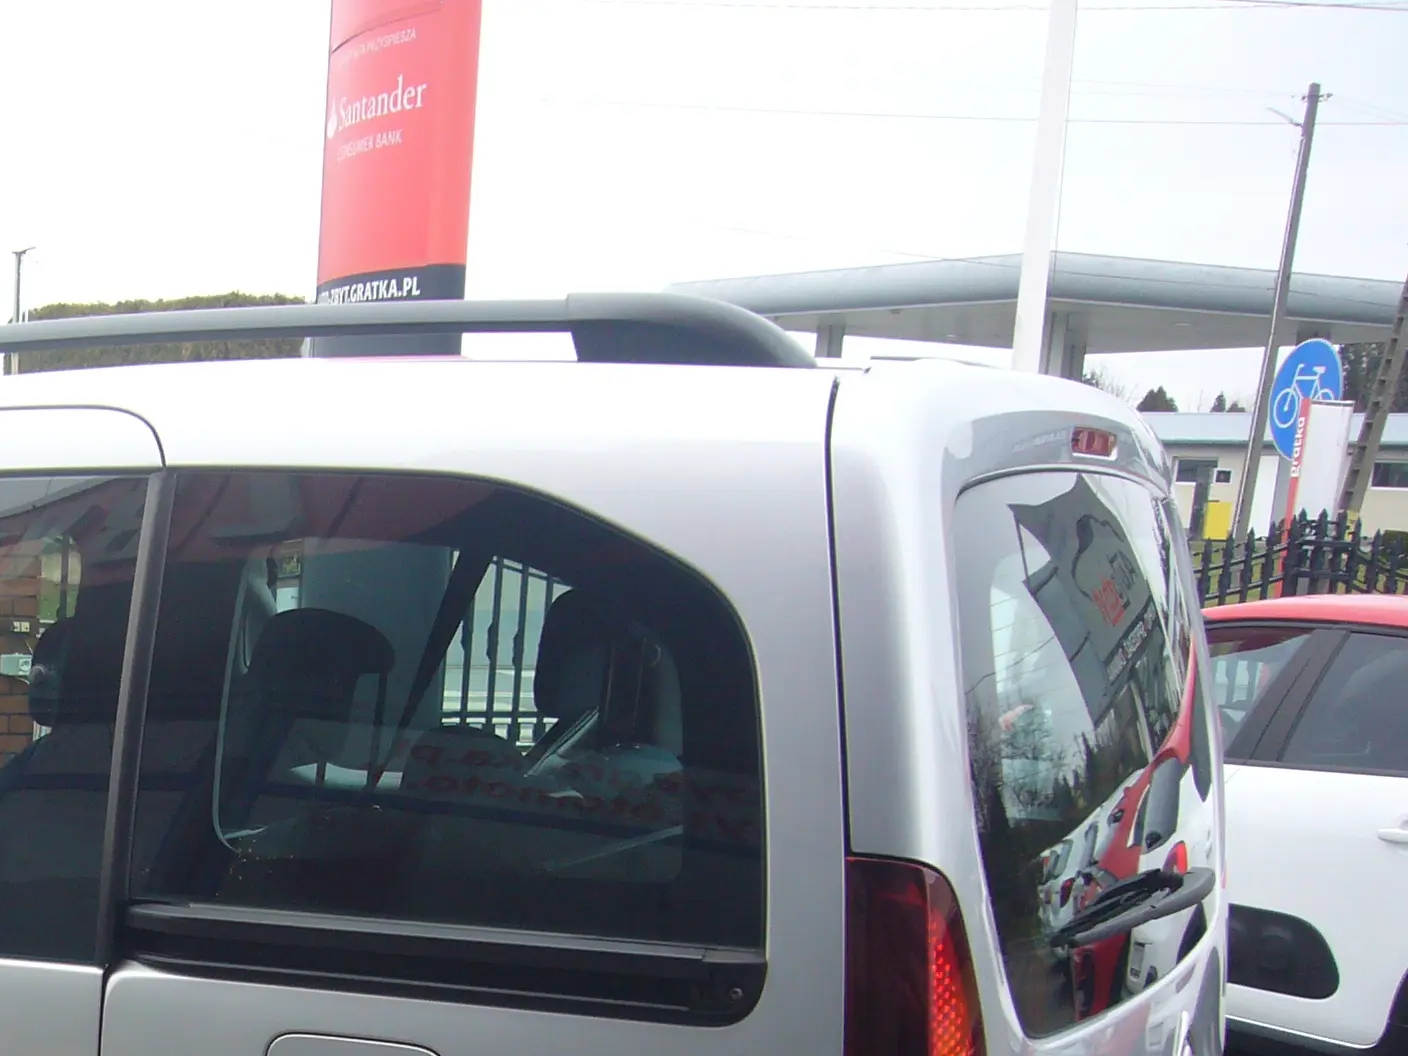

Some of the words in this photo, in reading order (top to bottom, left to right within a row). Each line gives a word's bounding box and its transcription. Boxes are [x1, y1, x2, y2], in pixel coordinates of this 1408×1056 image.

[339, 74, 427, 131] Santander
[337, 136, 374, 162] CONSUMER
[375, 128, 404, 150] BANK
